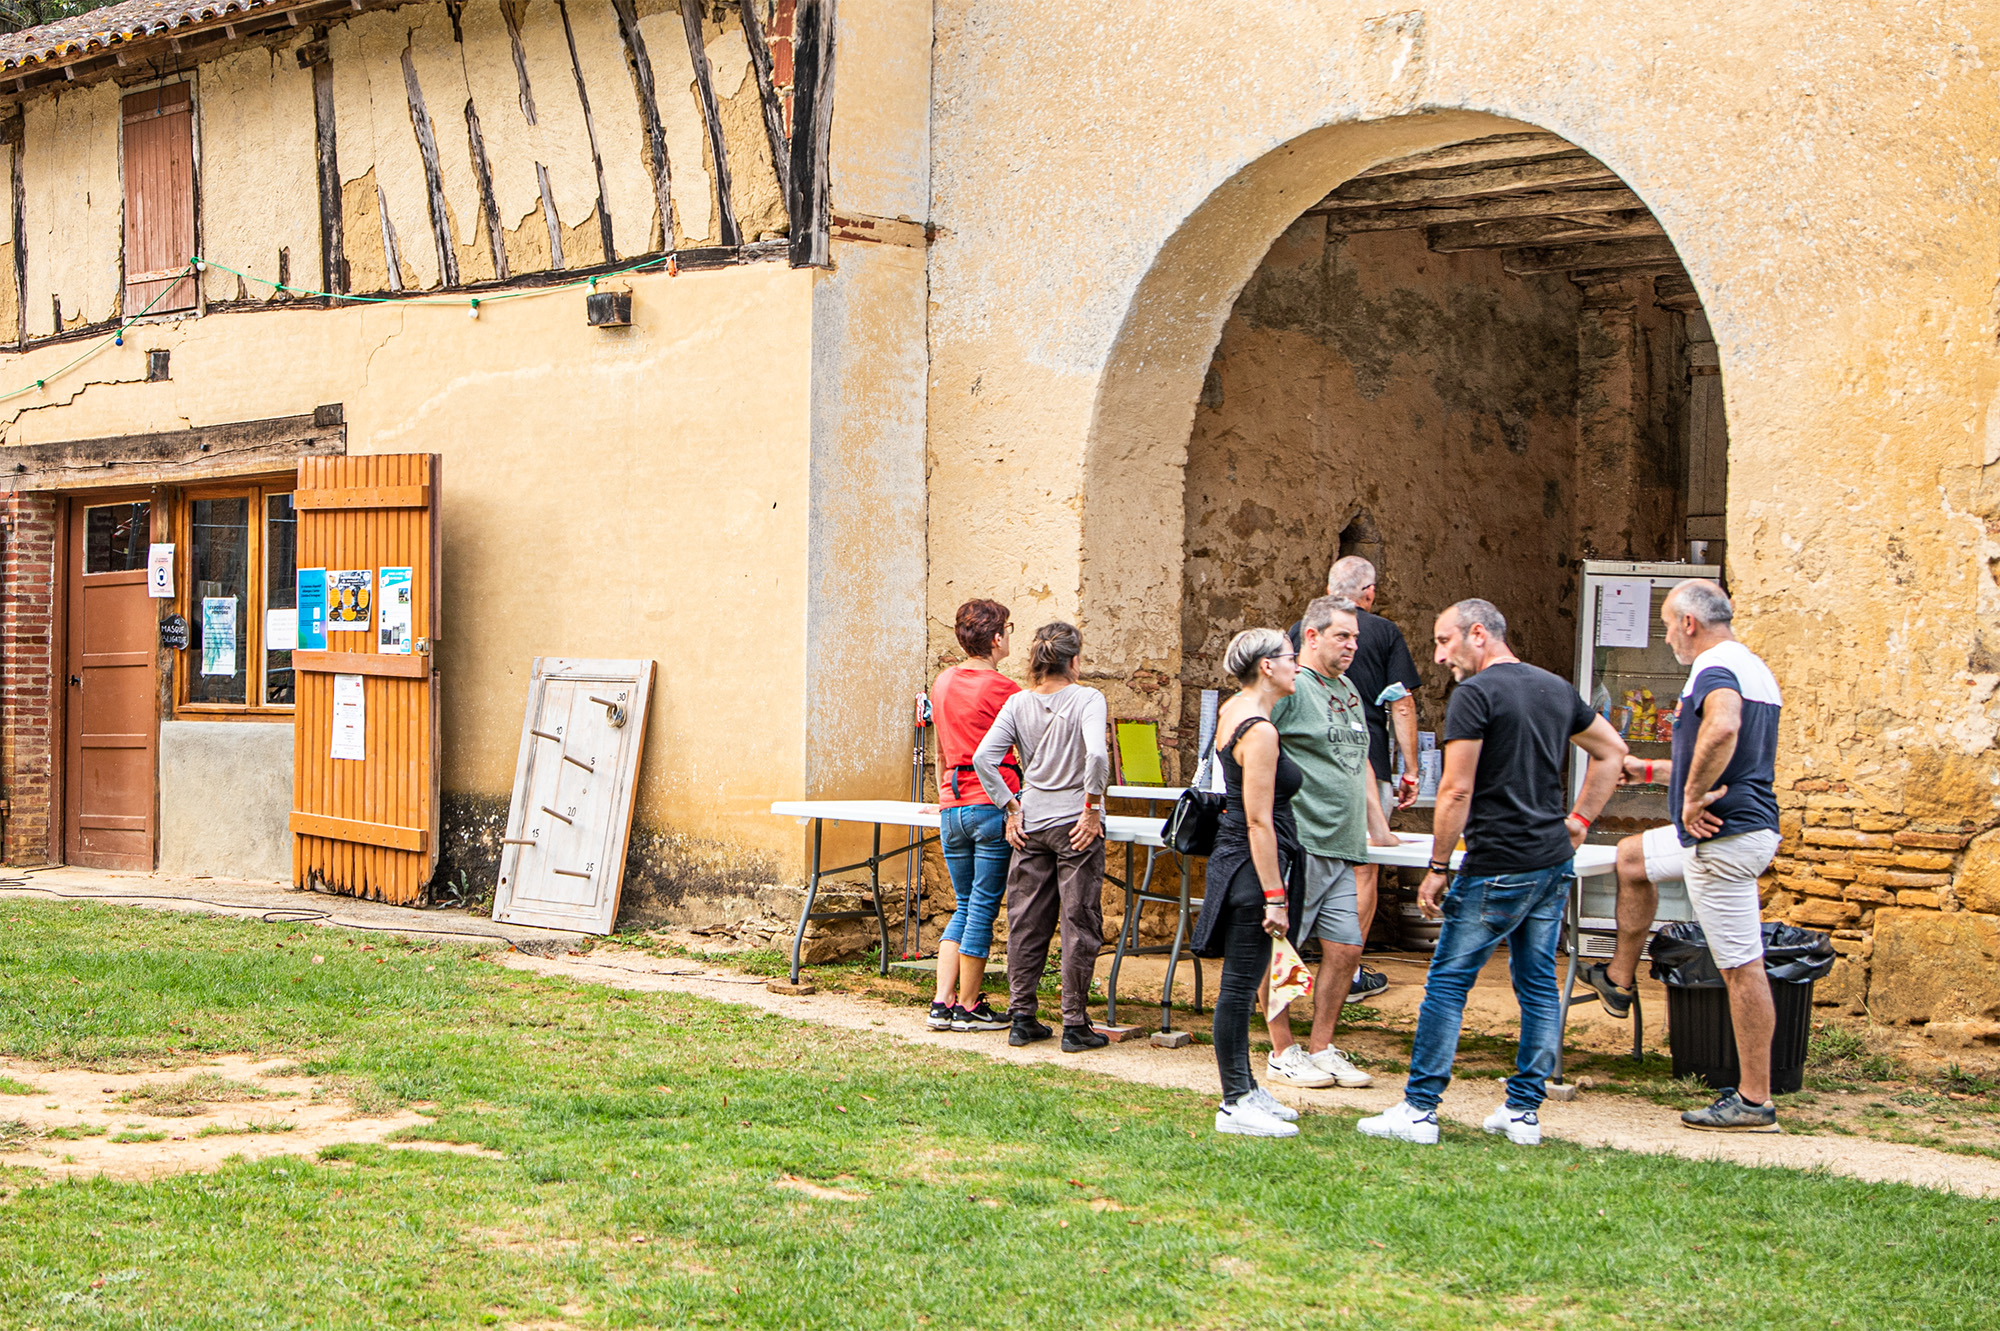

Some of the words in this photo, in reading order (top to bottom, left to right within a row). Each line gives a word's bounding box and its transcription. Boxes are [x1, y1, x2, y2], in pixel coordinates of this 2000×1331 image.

[617, 692, 626, 701] 30
[556, 726, 563, 735] 10
[590, 756, 596, 766] 5
[567, 806, 577, 817] 20
[532, 828, 540, 838] 15
[585, 862, 595, 872] 25
